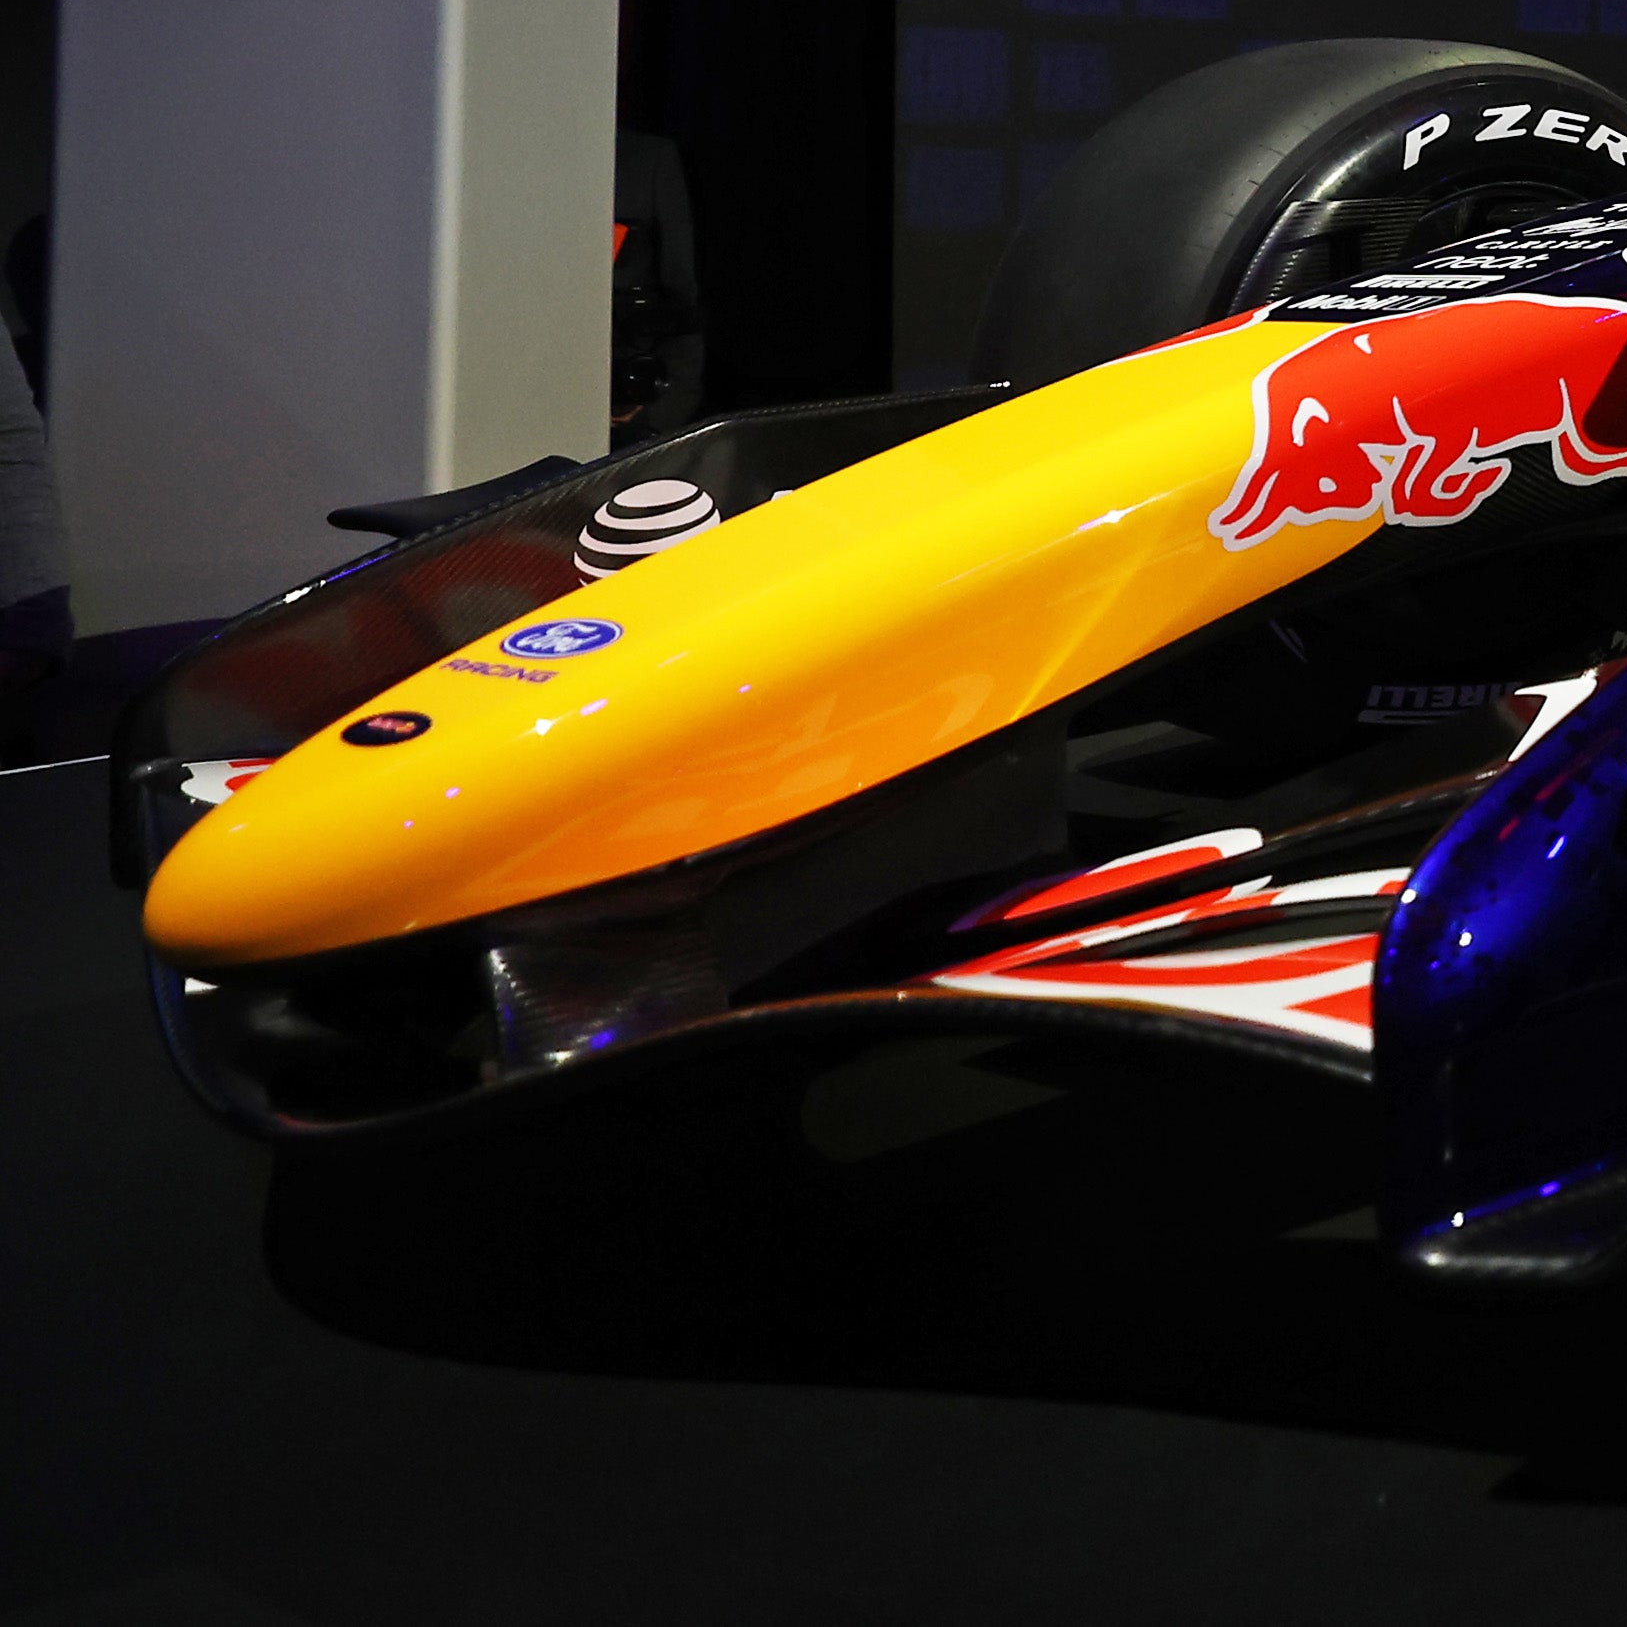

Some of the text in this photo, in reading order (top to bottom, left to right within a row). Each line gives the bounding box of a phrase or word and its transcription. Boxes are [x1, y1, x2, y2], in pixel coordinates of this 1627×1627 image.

[1403, 113, 1450, 171] P
[1350, 274, 1506, 289] PIRELLI
[1295, 294, 1403, 310] Mobil
[440, 659, 559, 683] RACING
[1358, 682, 1523, 724] IRELLI
